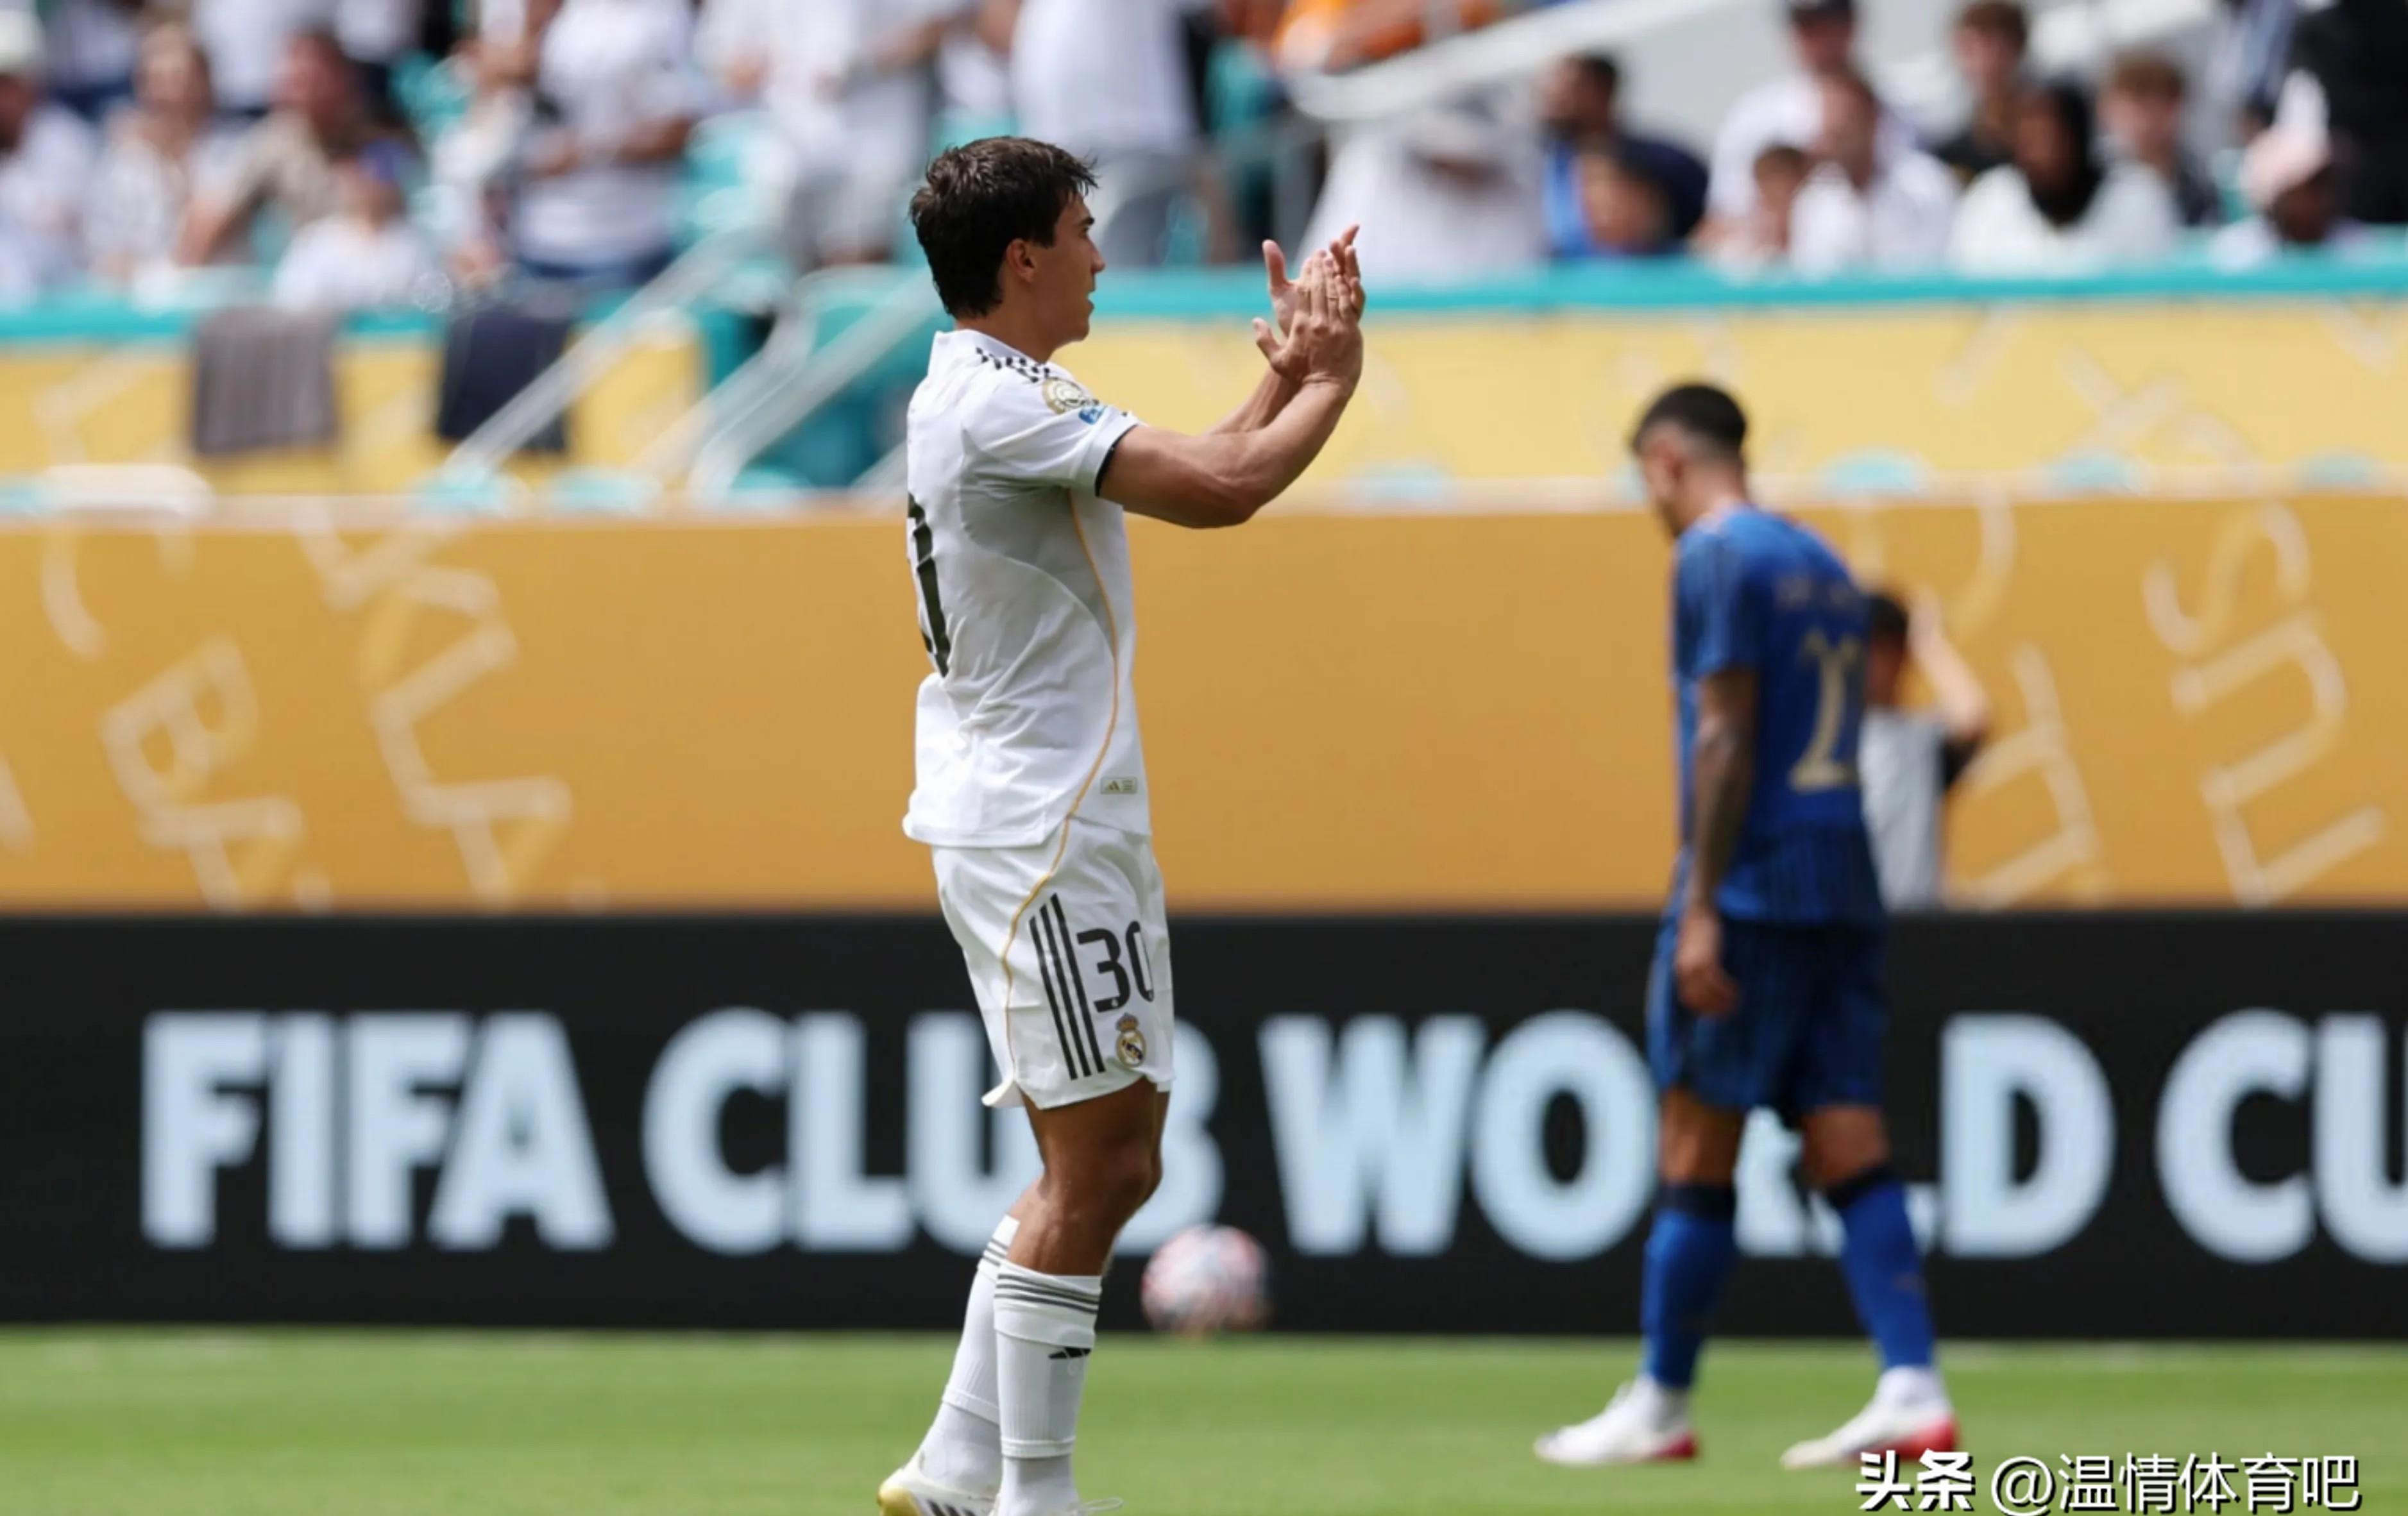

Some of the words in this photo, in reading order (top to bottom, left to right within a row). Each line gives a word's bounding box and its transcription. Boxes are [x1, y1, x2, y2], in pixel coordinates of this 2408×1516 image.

[1076, 920, 1155, 1013] 30
[142, 1011, 616, 1250] FIFA
[1256, 1008, 2115, 1261] WOD
